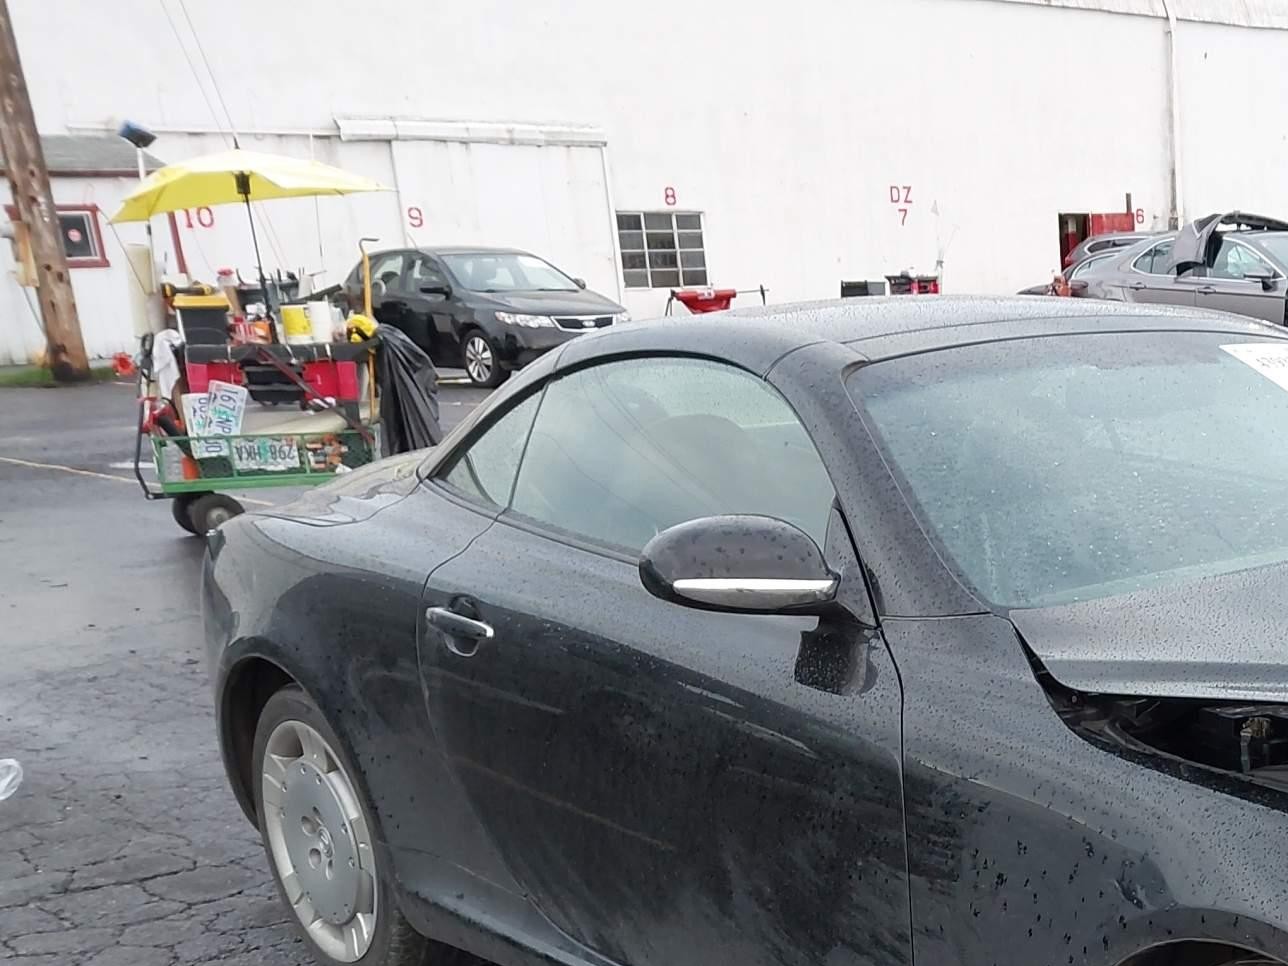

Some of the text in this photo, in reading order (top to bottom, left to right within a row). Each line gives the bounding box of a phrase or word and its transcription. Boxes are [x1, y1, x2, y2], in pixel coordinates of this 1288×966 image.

[664, 187, 677, 206] 8
[890, 186, 912, 203] DZ
[182, 206, 214, 228] 10
[407, 207, 424, 228] 9
[898, 209, 908, 226] 7
[1135, 208, 1145, 224] 6
